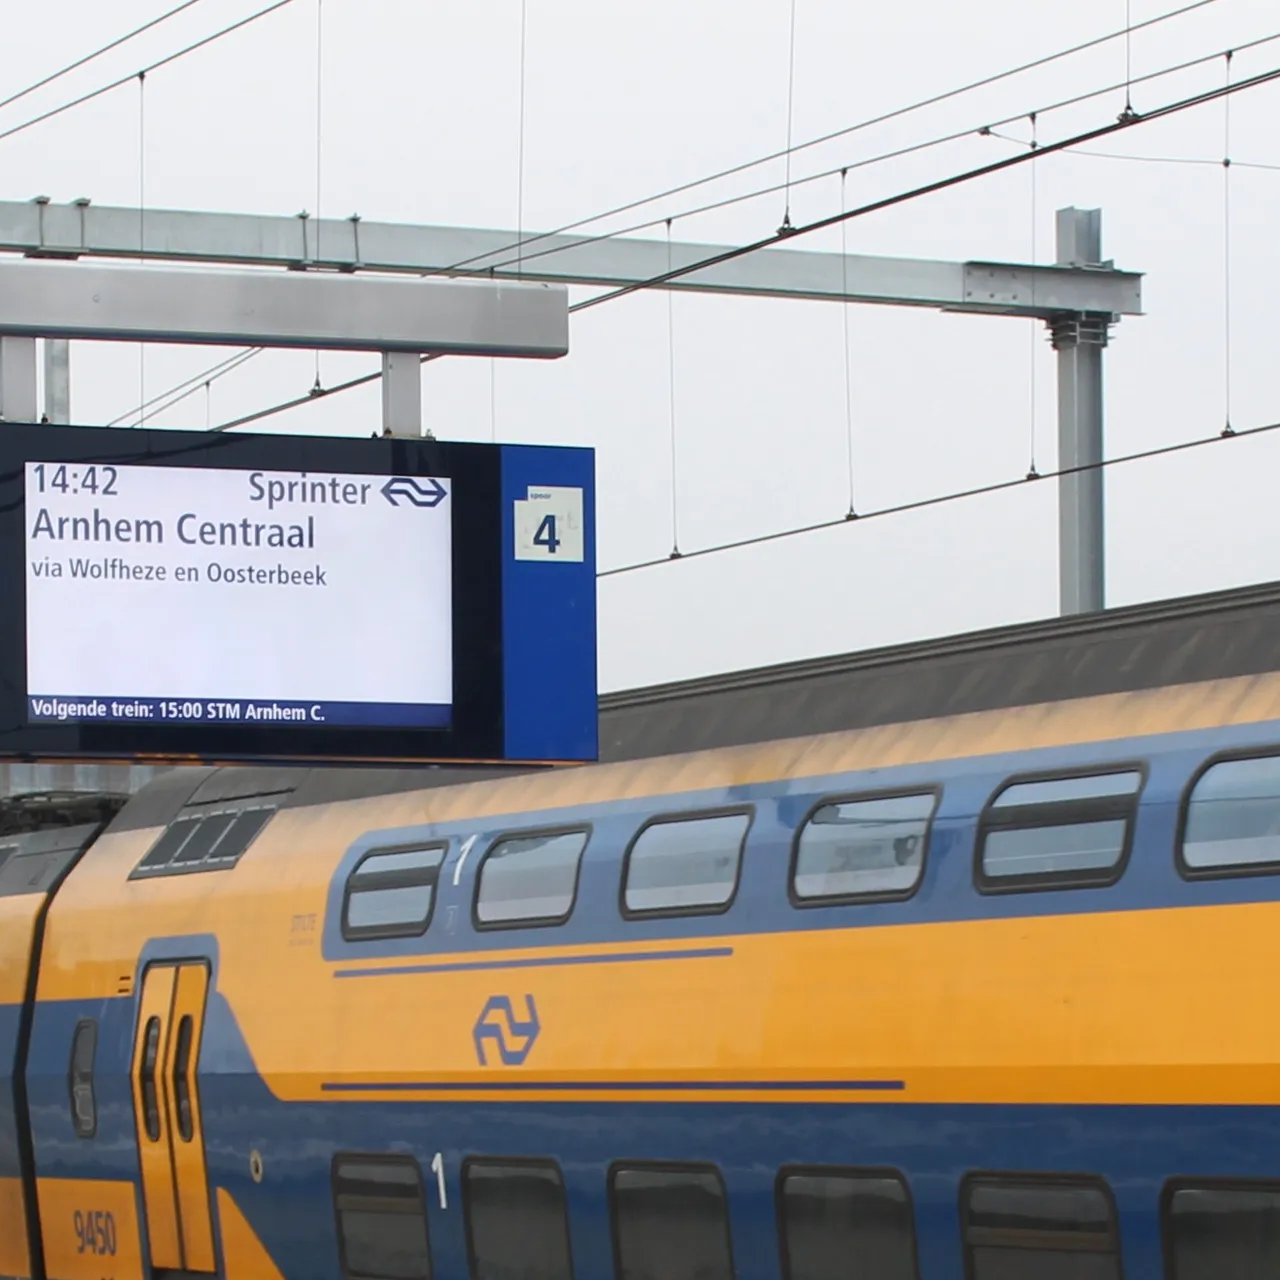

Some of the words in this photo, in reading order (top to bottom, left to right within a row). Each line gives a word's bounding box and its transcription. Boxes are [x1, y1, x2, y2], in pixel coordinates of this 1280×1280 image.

[33, 463, 119, 496] 14:42
[248, 471, 372, 511] Sprinter
[31, 507, 164, 544] Arnhem
[176, 512, 315, 549] Centraal
[532, 514, 562, 554] 4
[31, 556, 63, 578] via
[68, 557, 167, 581] Wolfheze
[174, 565, 199, 582] en
[206, 562, 328, 586] Oosterbeek
[31, 698, 108, 721] Volgende
[111, 700, 154, 718] trein:
[159, 701, 203, 719] 15:00
[206, 702, 241, 720] STM
[244, 703, 307, 721] Arnhem
[310, 704, 326, 722] C.
[452, 833, 478, 886] 1
[431, 1151, 448, 1210] 1
[73, 1209, 118, 1257] 9450
